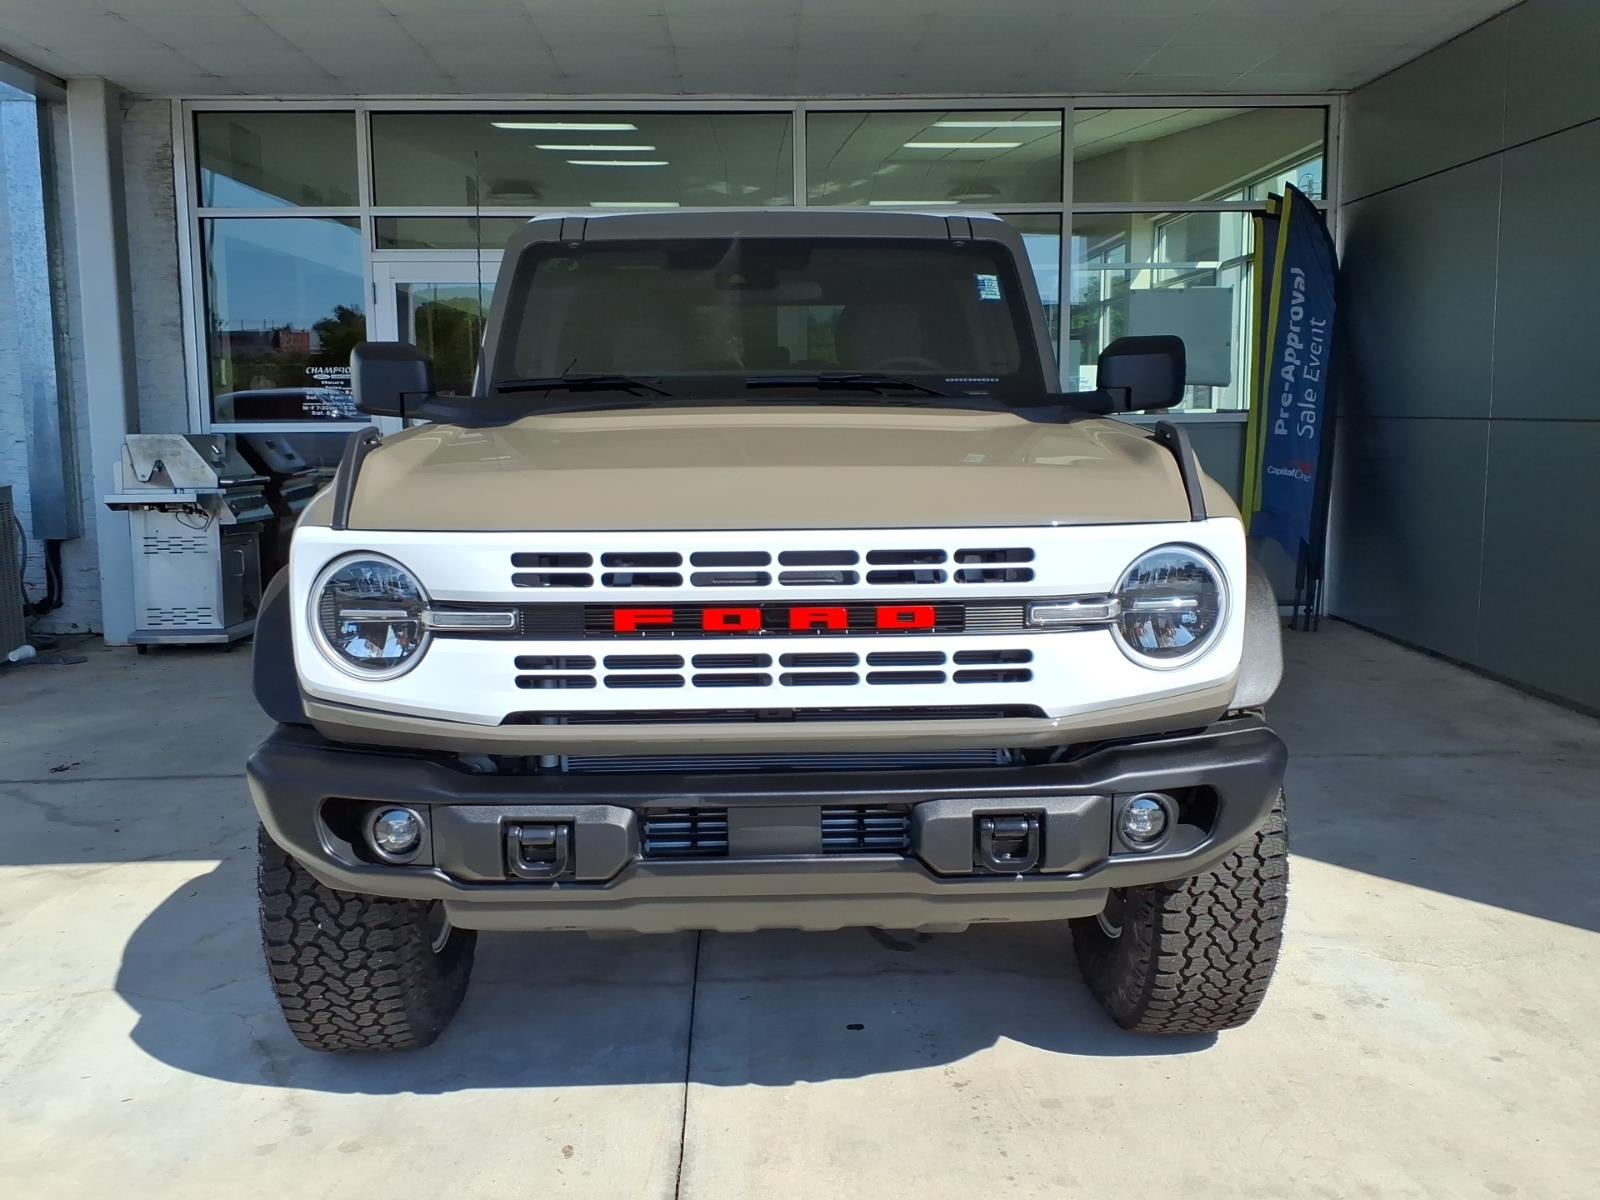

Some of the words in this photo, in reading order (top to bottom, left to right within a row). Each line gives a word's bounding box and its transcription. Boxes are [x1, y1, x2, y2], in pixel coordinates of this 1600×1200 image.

[305, 366, 351, 374] CHAMPIO
[1274, 267, 1306, 436] Pre-Approval
[1303, 316, 1327, 383] Event
[1295, 388, 1317, 440] Sale
[613, 606, 936, 631] FORD
